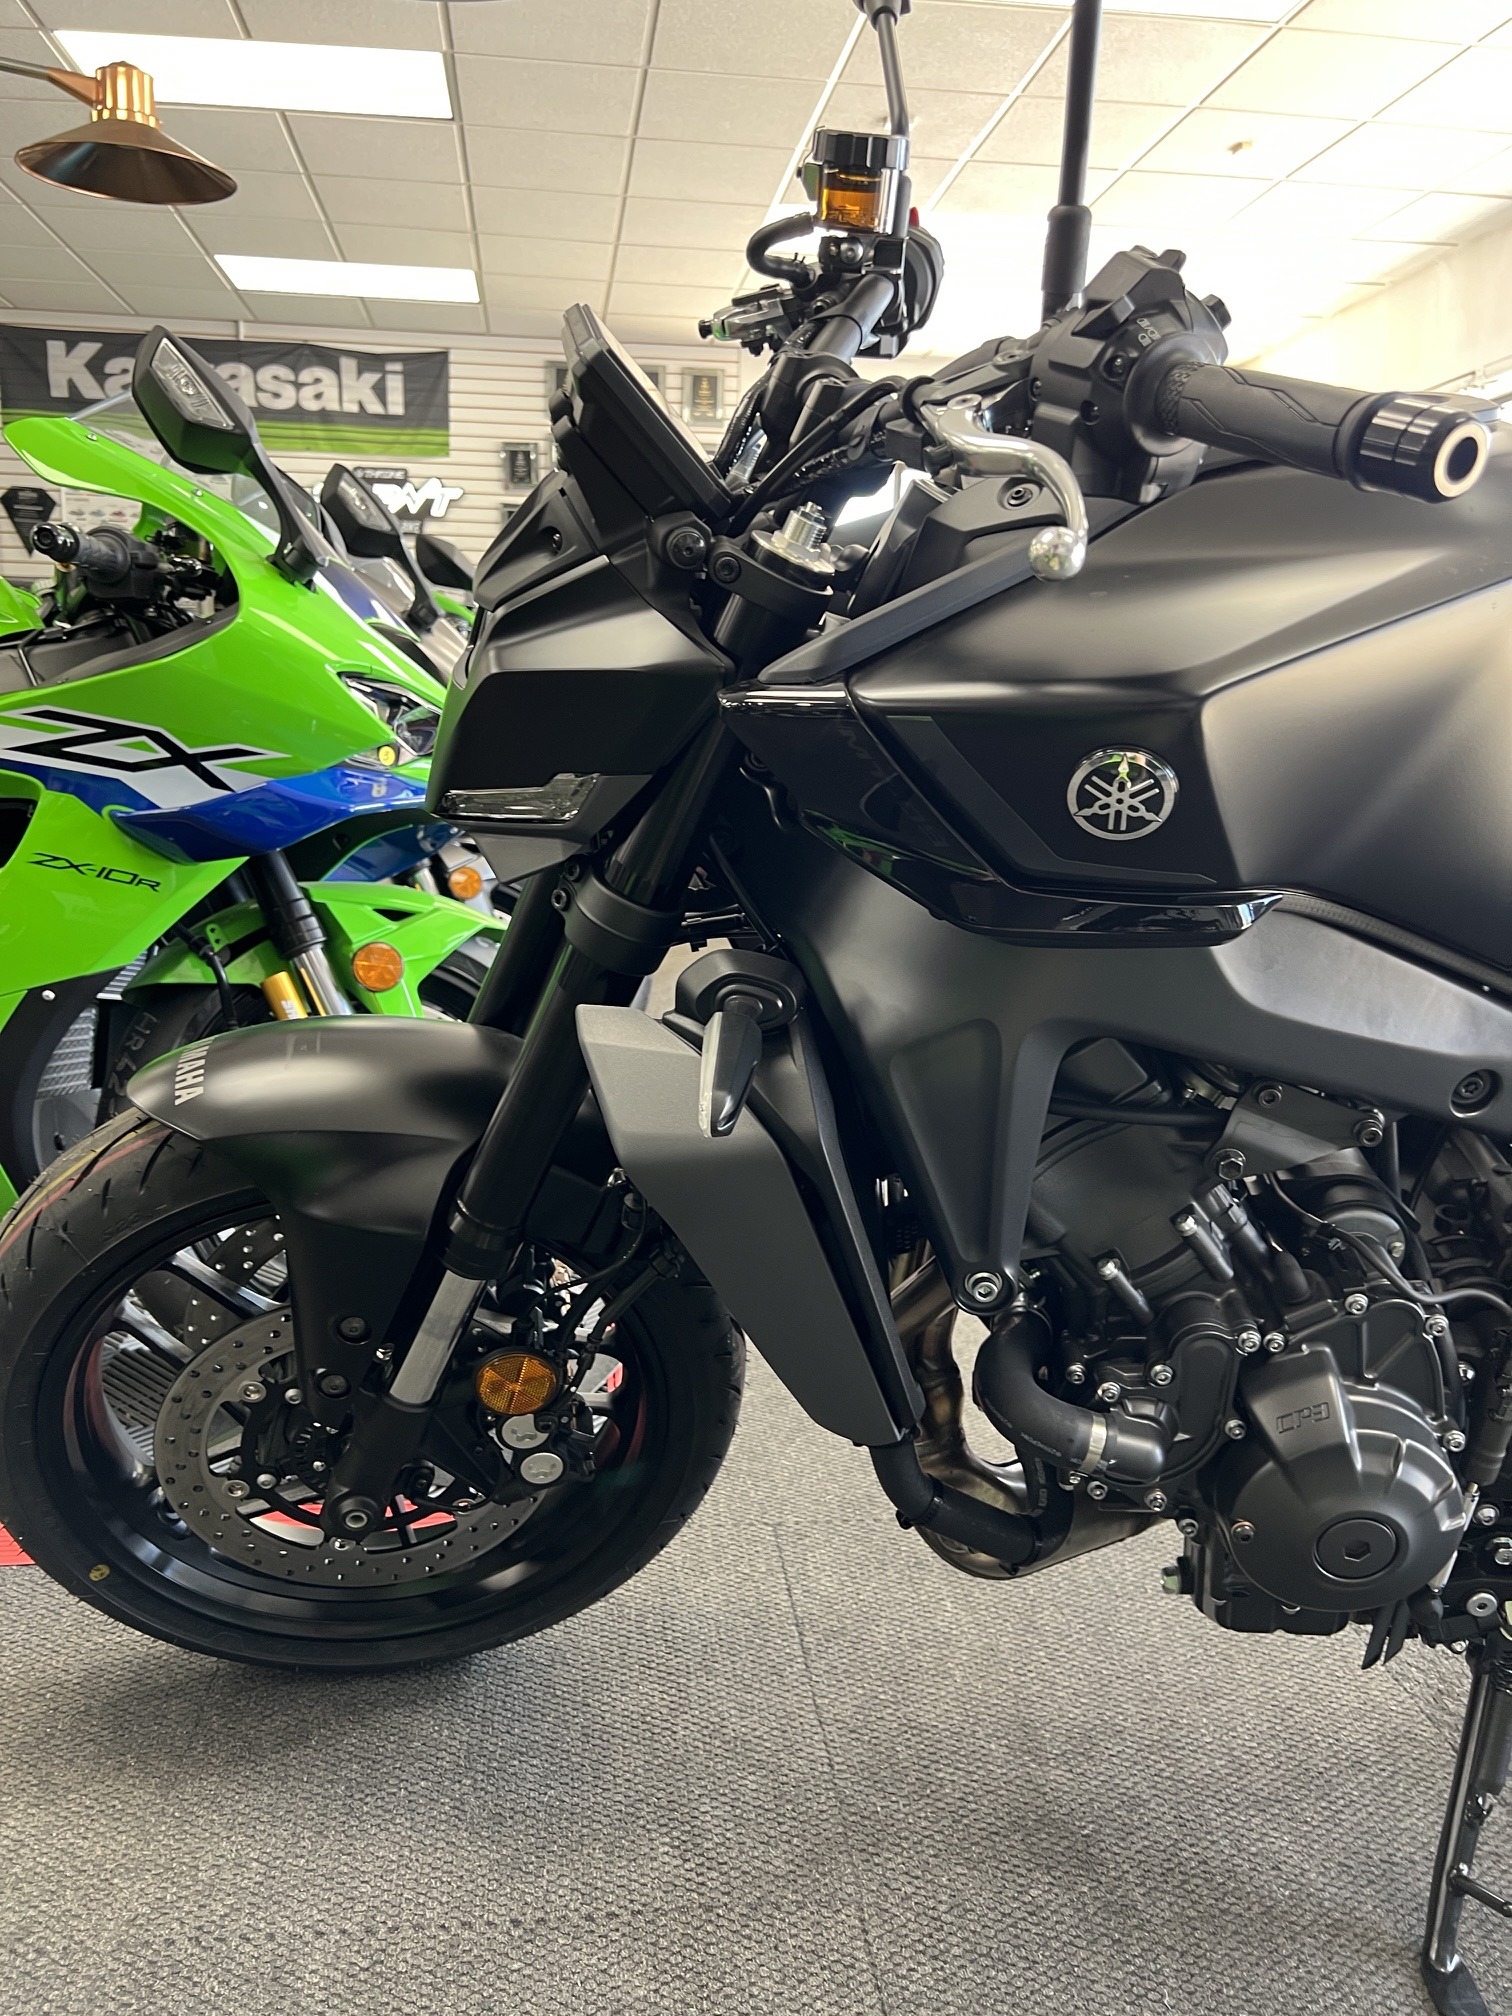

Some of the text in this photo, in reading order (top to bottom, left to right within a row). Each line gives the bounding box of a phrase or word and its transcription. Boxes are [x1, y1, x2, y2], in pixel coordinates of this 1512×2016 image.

[46, 339, 405, 415] Kaasaki
[27, 852, 162, 893] ZX-10R
[1276, 1401, 1330, 1434] CP3
